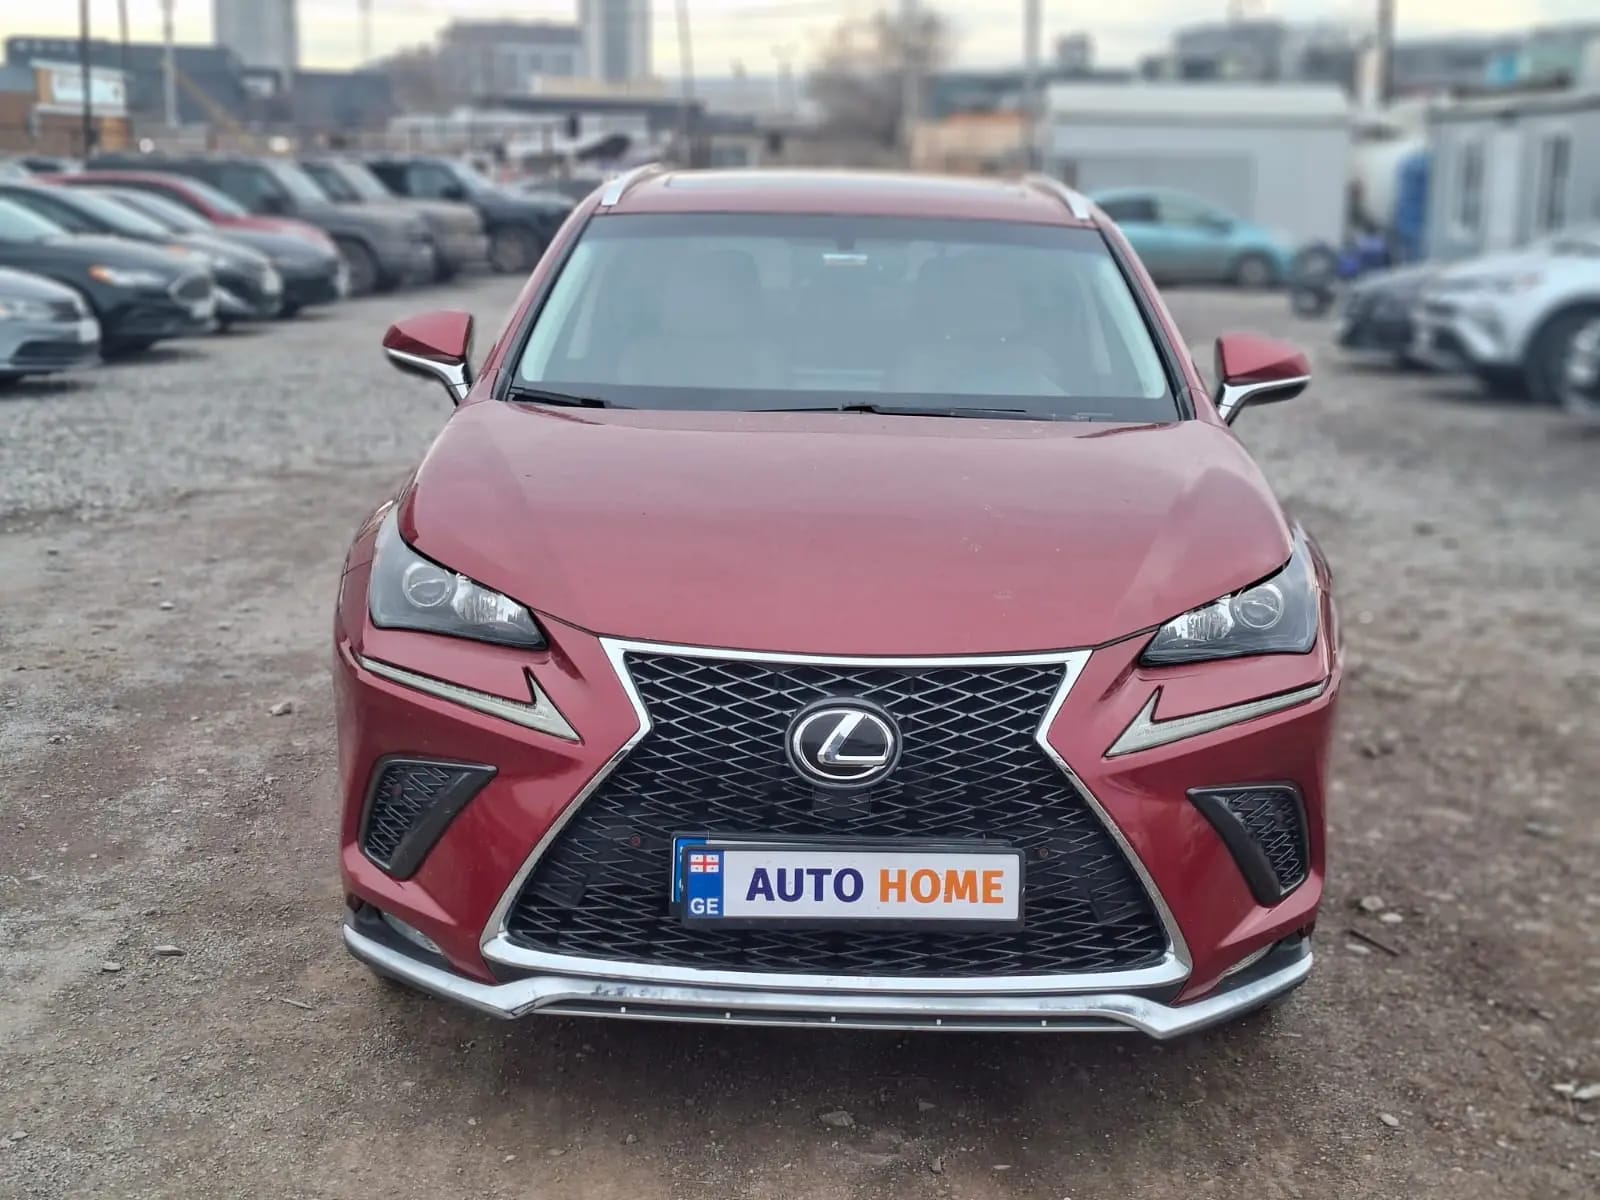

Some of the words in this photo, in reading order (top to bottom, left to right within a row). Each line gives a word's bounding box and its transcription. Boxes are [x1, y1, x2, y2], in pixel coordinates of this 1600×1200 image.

[746, 868, 864, 902] AUTO
[879, 869, 1004, 904] HOME
[690, 898, 719, 915] GE
